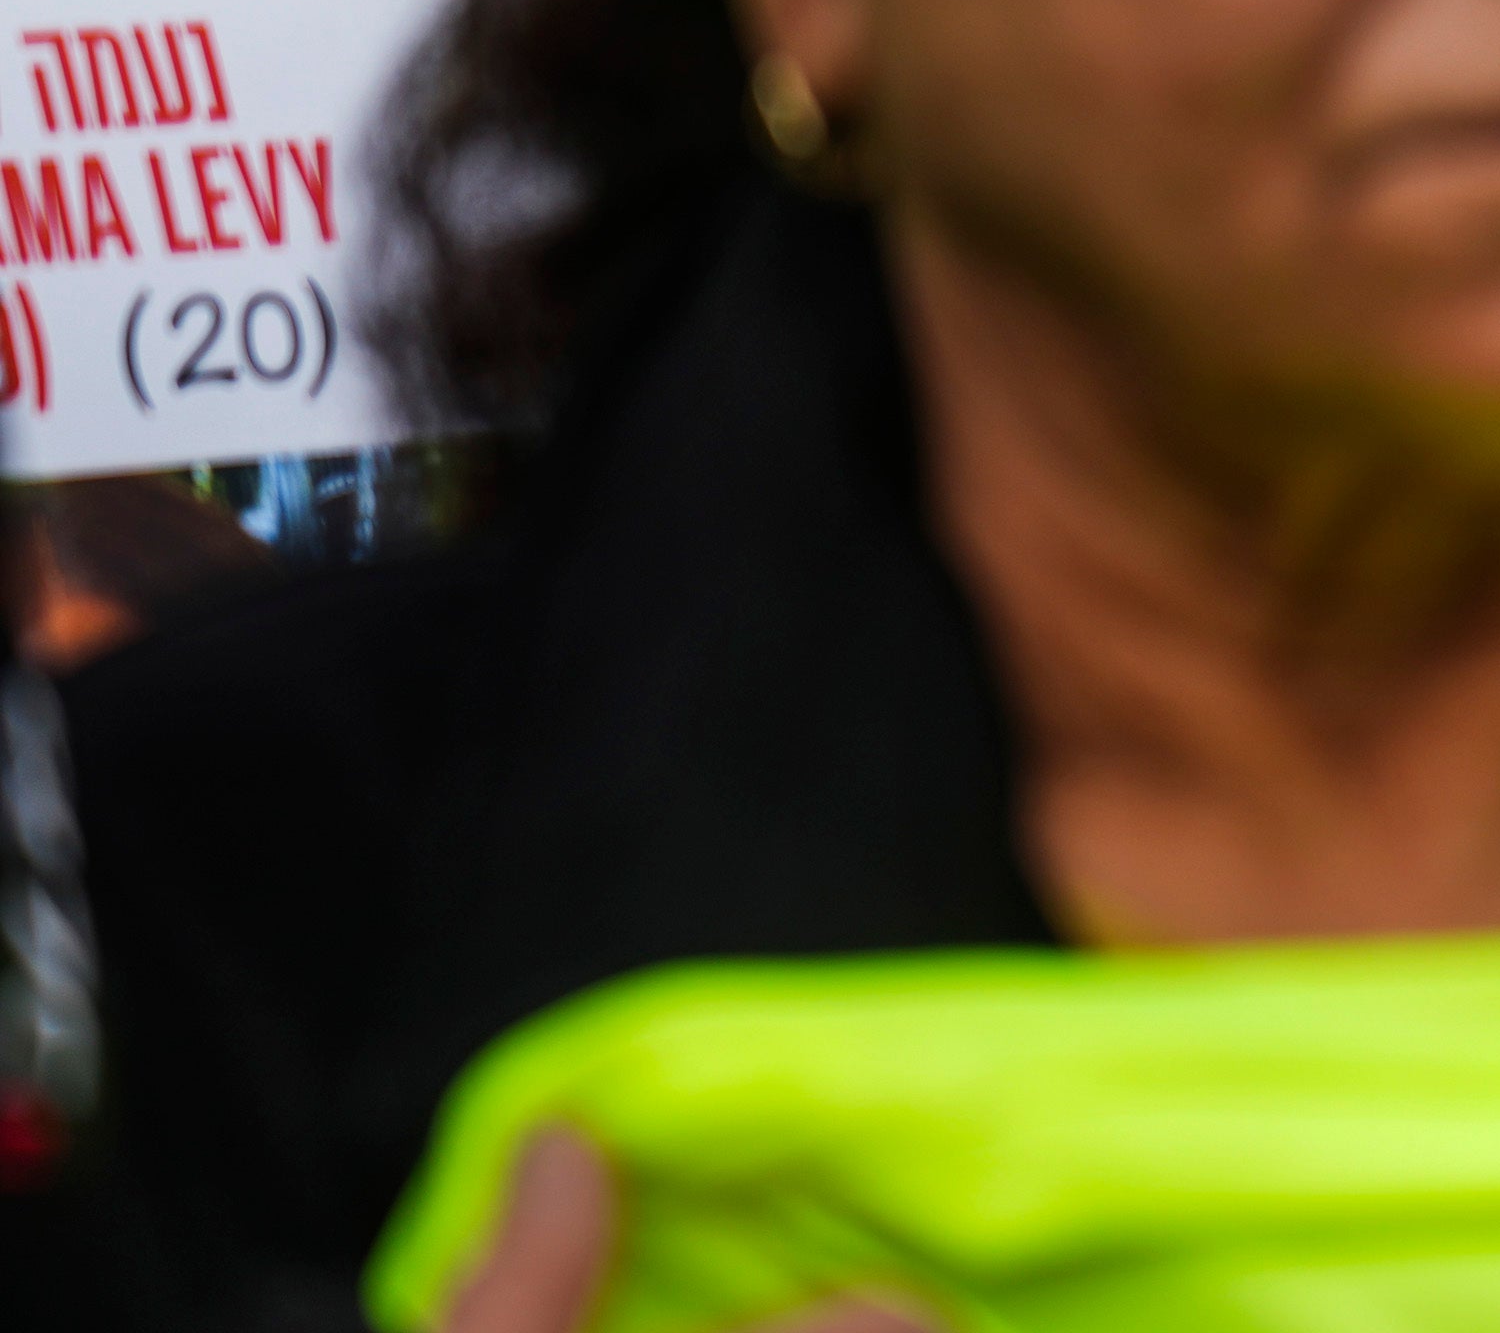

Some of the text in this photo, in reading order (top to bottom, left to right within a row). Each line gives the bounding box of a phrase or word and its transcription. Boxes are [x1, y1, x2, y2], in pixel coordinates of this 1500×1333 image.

[22, 21, 230, 132] נעמה
[0, 138, 335, 267] MA LEVY
[120, 276, 336, 410] (20)
